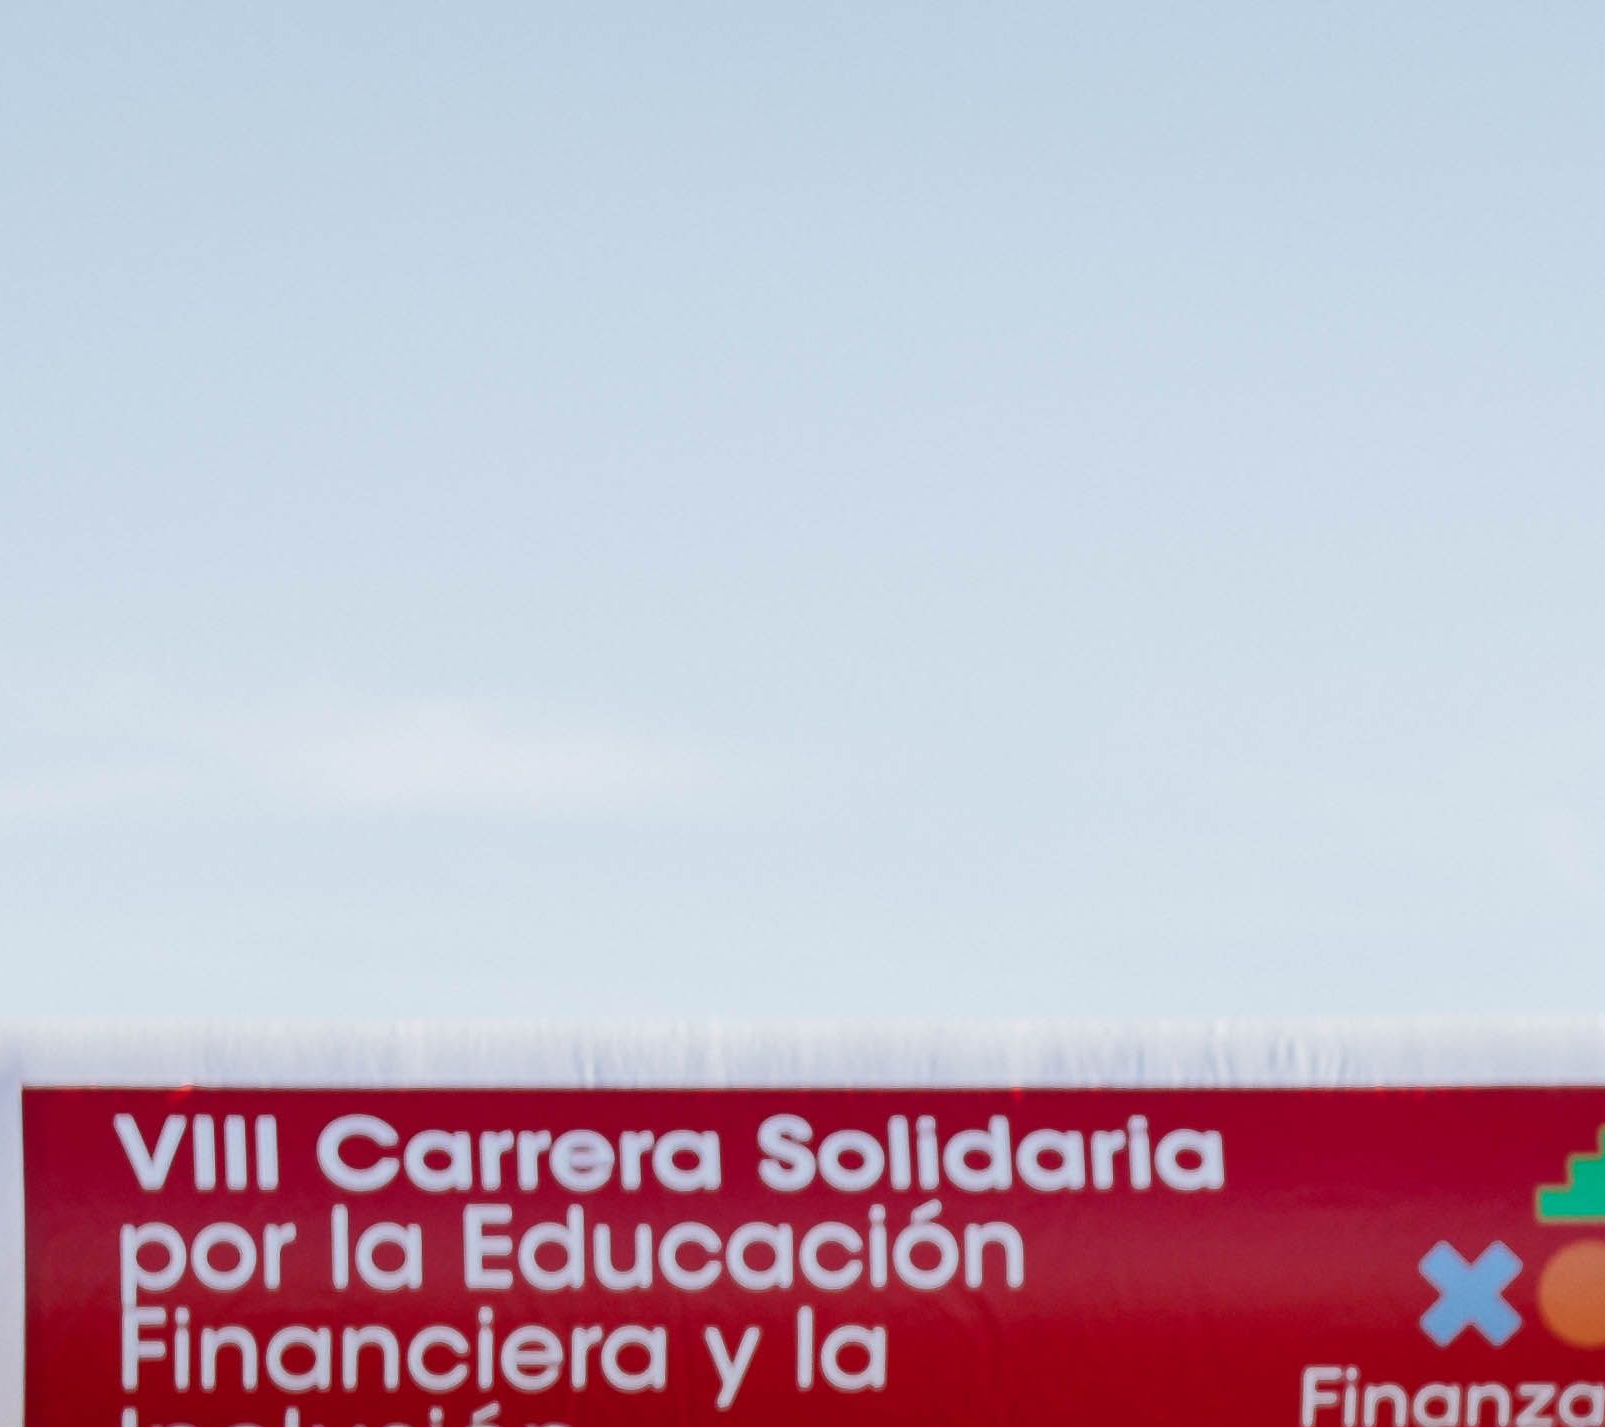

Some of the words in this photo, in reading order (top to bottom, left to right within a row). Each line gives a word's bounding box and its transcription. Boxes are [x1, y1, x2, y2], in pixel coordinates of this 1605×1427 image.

[115, 1114, 279, 1191] VIII
[317, 1114, 722, 1192] Carrera
[757, 1113, 1225, 1192] Solidaria
[119, 1221, 297, 1304] por
[331, 1204, 423, 1291] la
[463, 1198, 1024, 1292] Educación
[120, 1310, 668, 1393] Financiera
[705, 1326, 760, 1411] y
[797, 1309, 887, 1391] la
